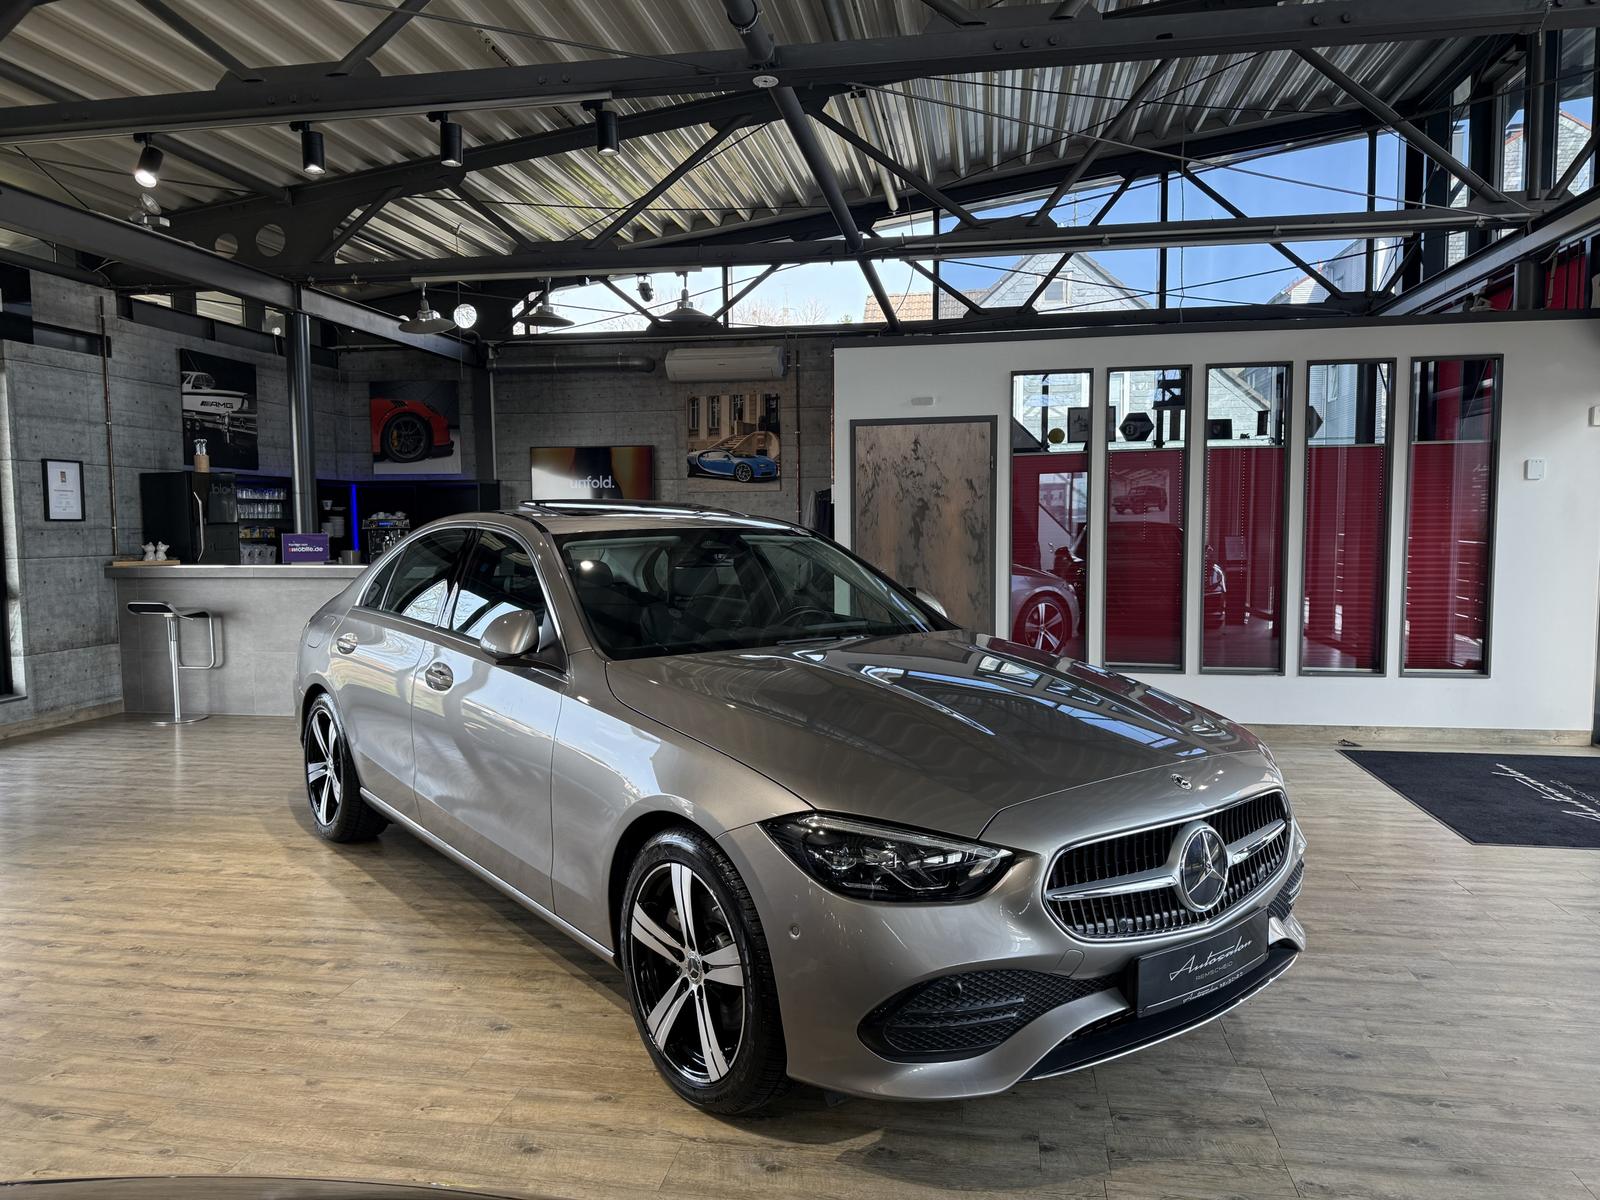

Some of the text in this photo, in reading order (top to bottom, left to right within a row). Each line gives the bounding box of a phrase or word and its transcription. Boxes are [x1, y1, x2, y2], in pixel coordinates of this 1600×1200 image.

[210, 401, 233, 409] AMG
[570, 475, 615, 489] unfold.
[1169, 935, 1252, 981] Autosalon
